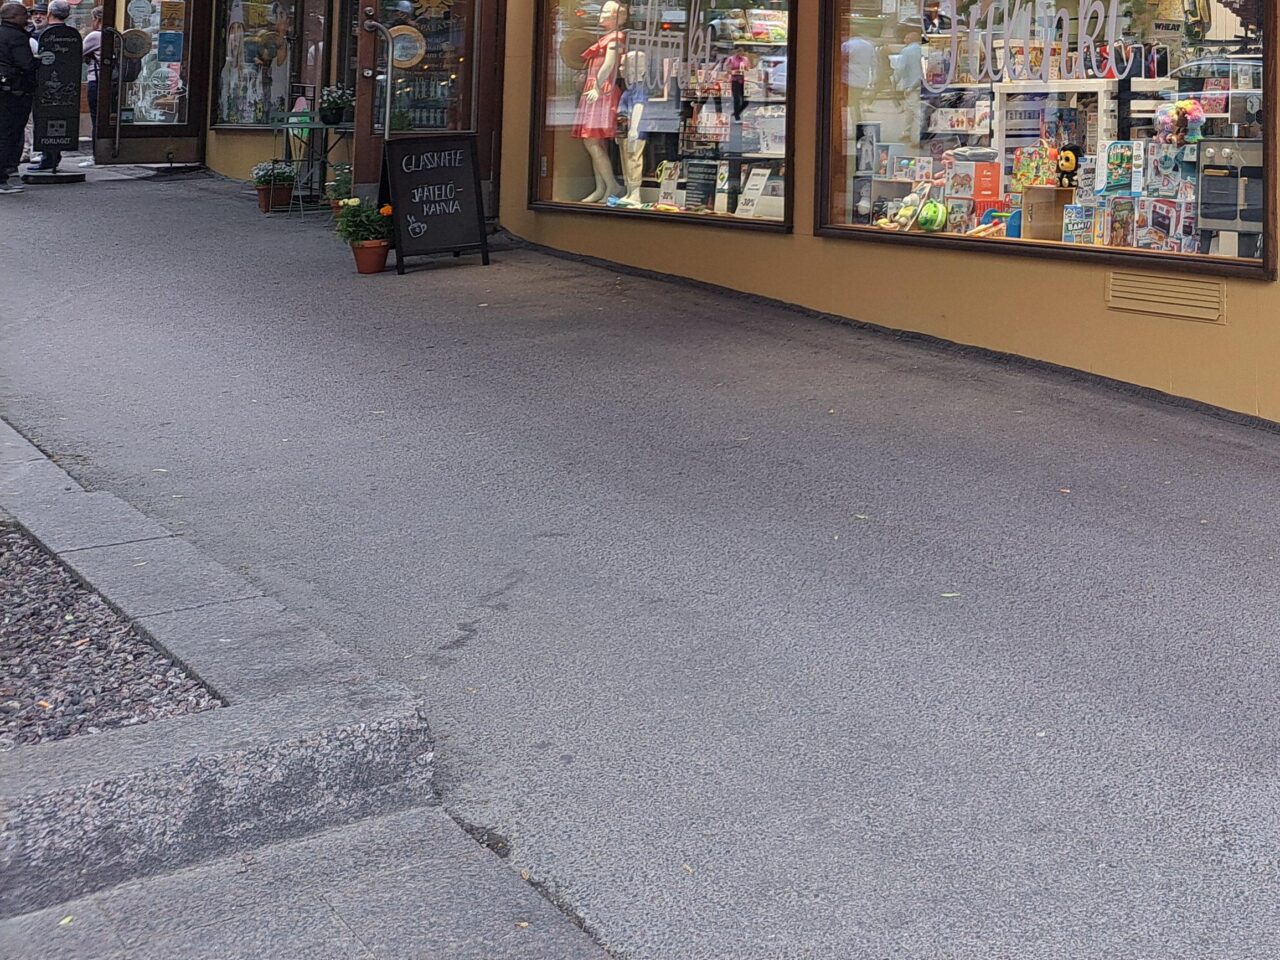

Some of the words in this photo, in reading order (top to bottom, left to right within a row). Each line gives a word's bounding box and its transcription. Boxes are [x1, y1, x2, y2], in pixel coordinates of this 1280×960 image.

[1154, 22, 1181, 31] WHEAT
[402, 149, 464, 173] GLASSKAFFE
[423, 200, 461, 216] KAHVIA
